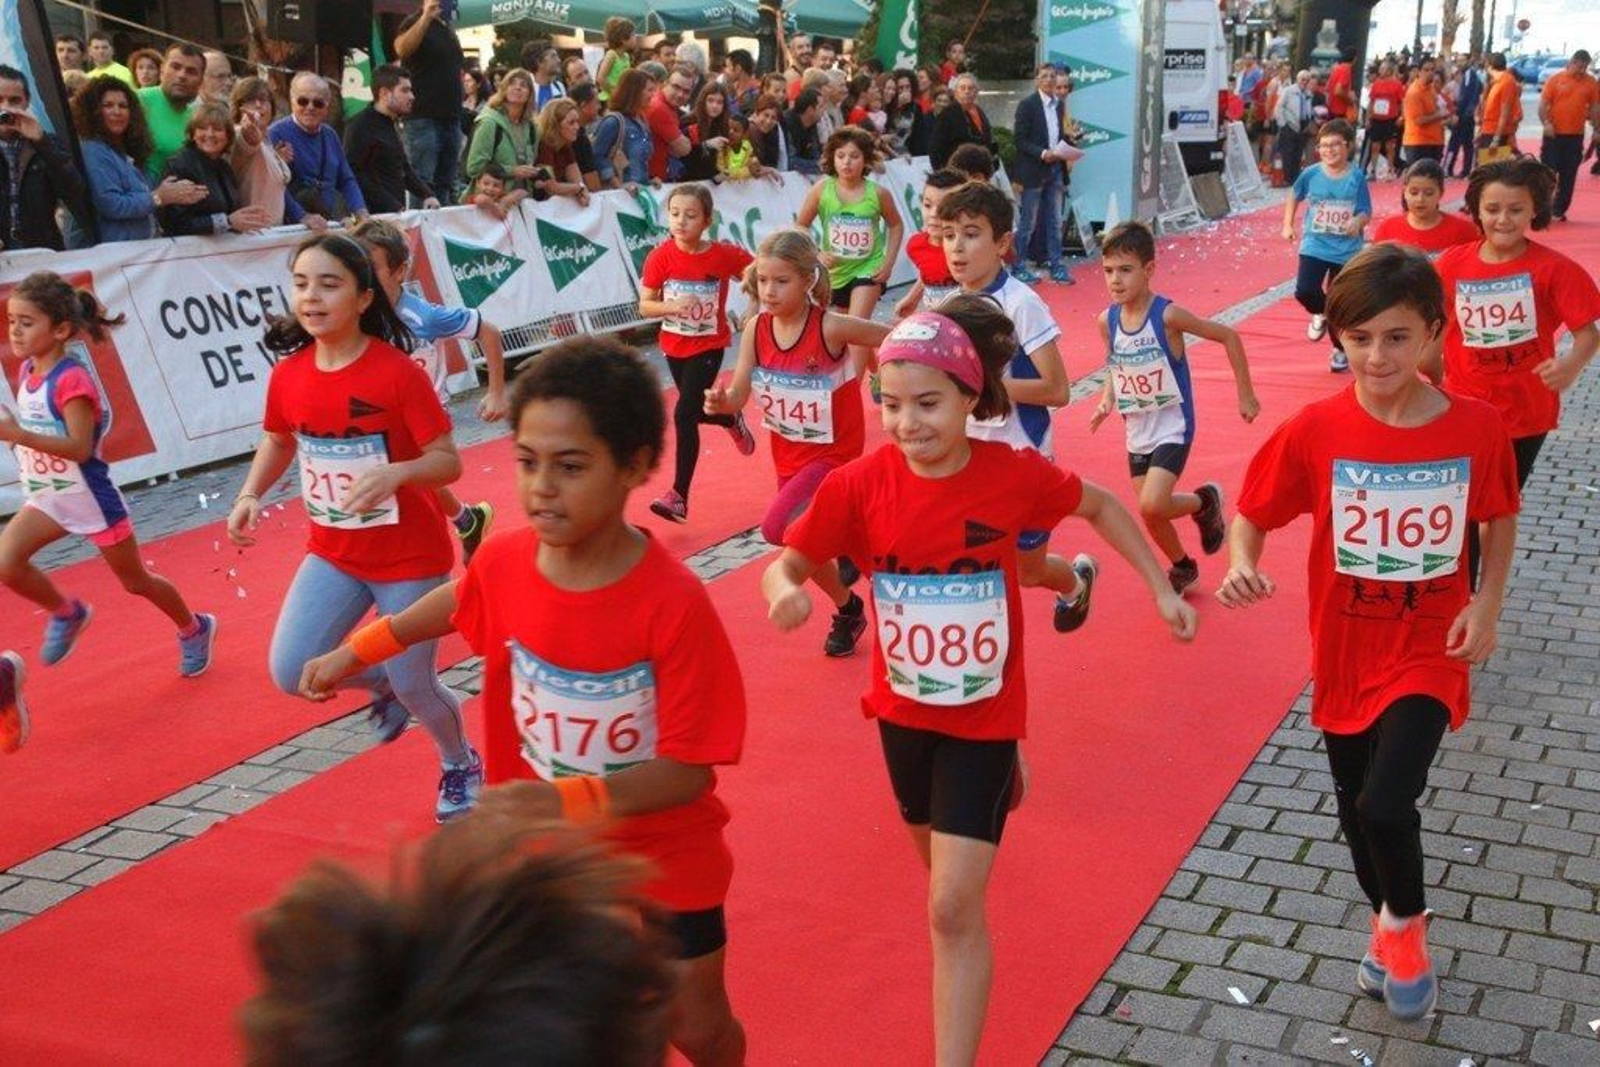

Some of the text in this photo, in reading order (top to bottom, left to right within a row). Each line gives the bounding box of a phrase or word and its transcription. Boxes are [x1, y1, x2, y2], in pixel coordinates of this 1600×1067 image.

[492, 0, 571, 14] MONDARIZ
[1316, 209, 1350, 224] 2109
[832, 230, 869, 247] 2103
[1461, 300, 1527, 328] 2194
[201, 344, 255, 389] DE
[1118, 368, 1163, 395] 2187
[760, 394, 820, 423] 2141
[306, 467, 353, 502] 213
[1343, 504, 1453, 548] 2169
[884, 619, 999, 667] 2086
[520, 694, 641, 757] 2176
